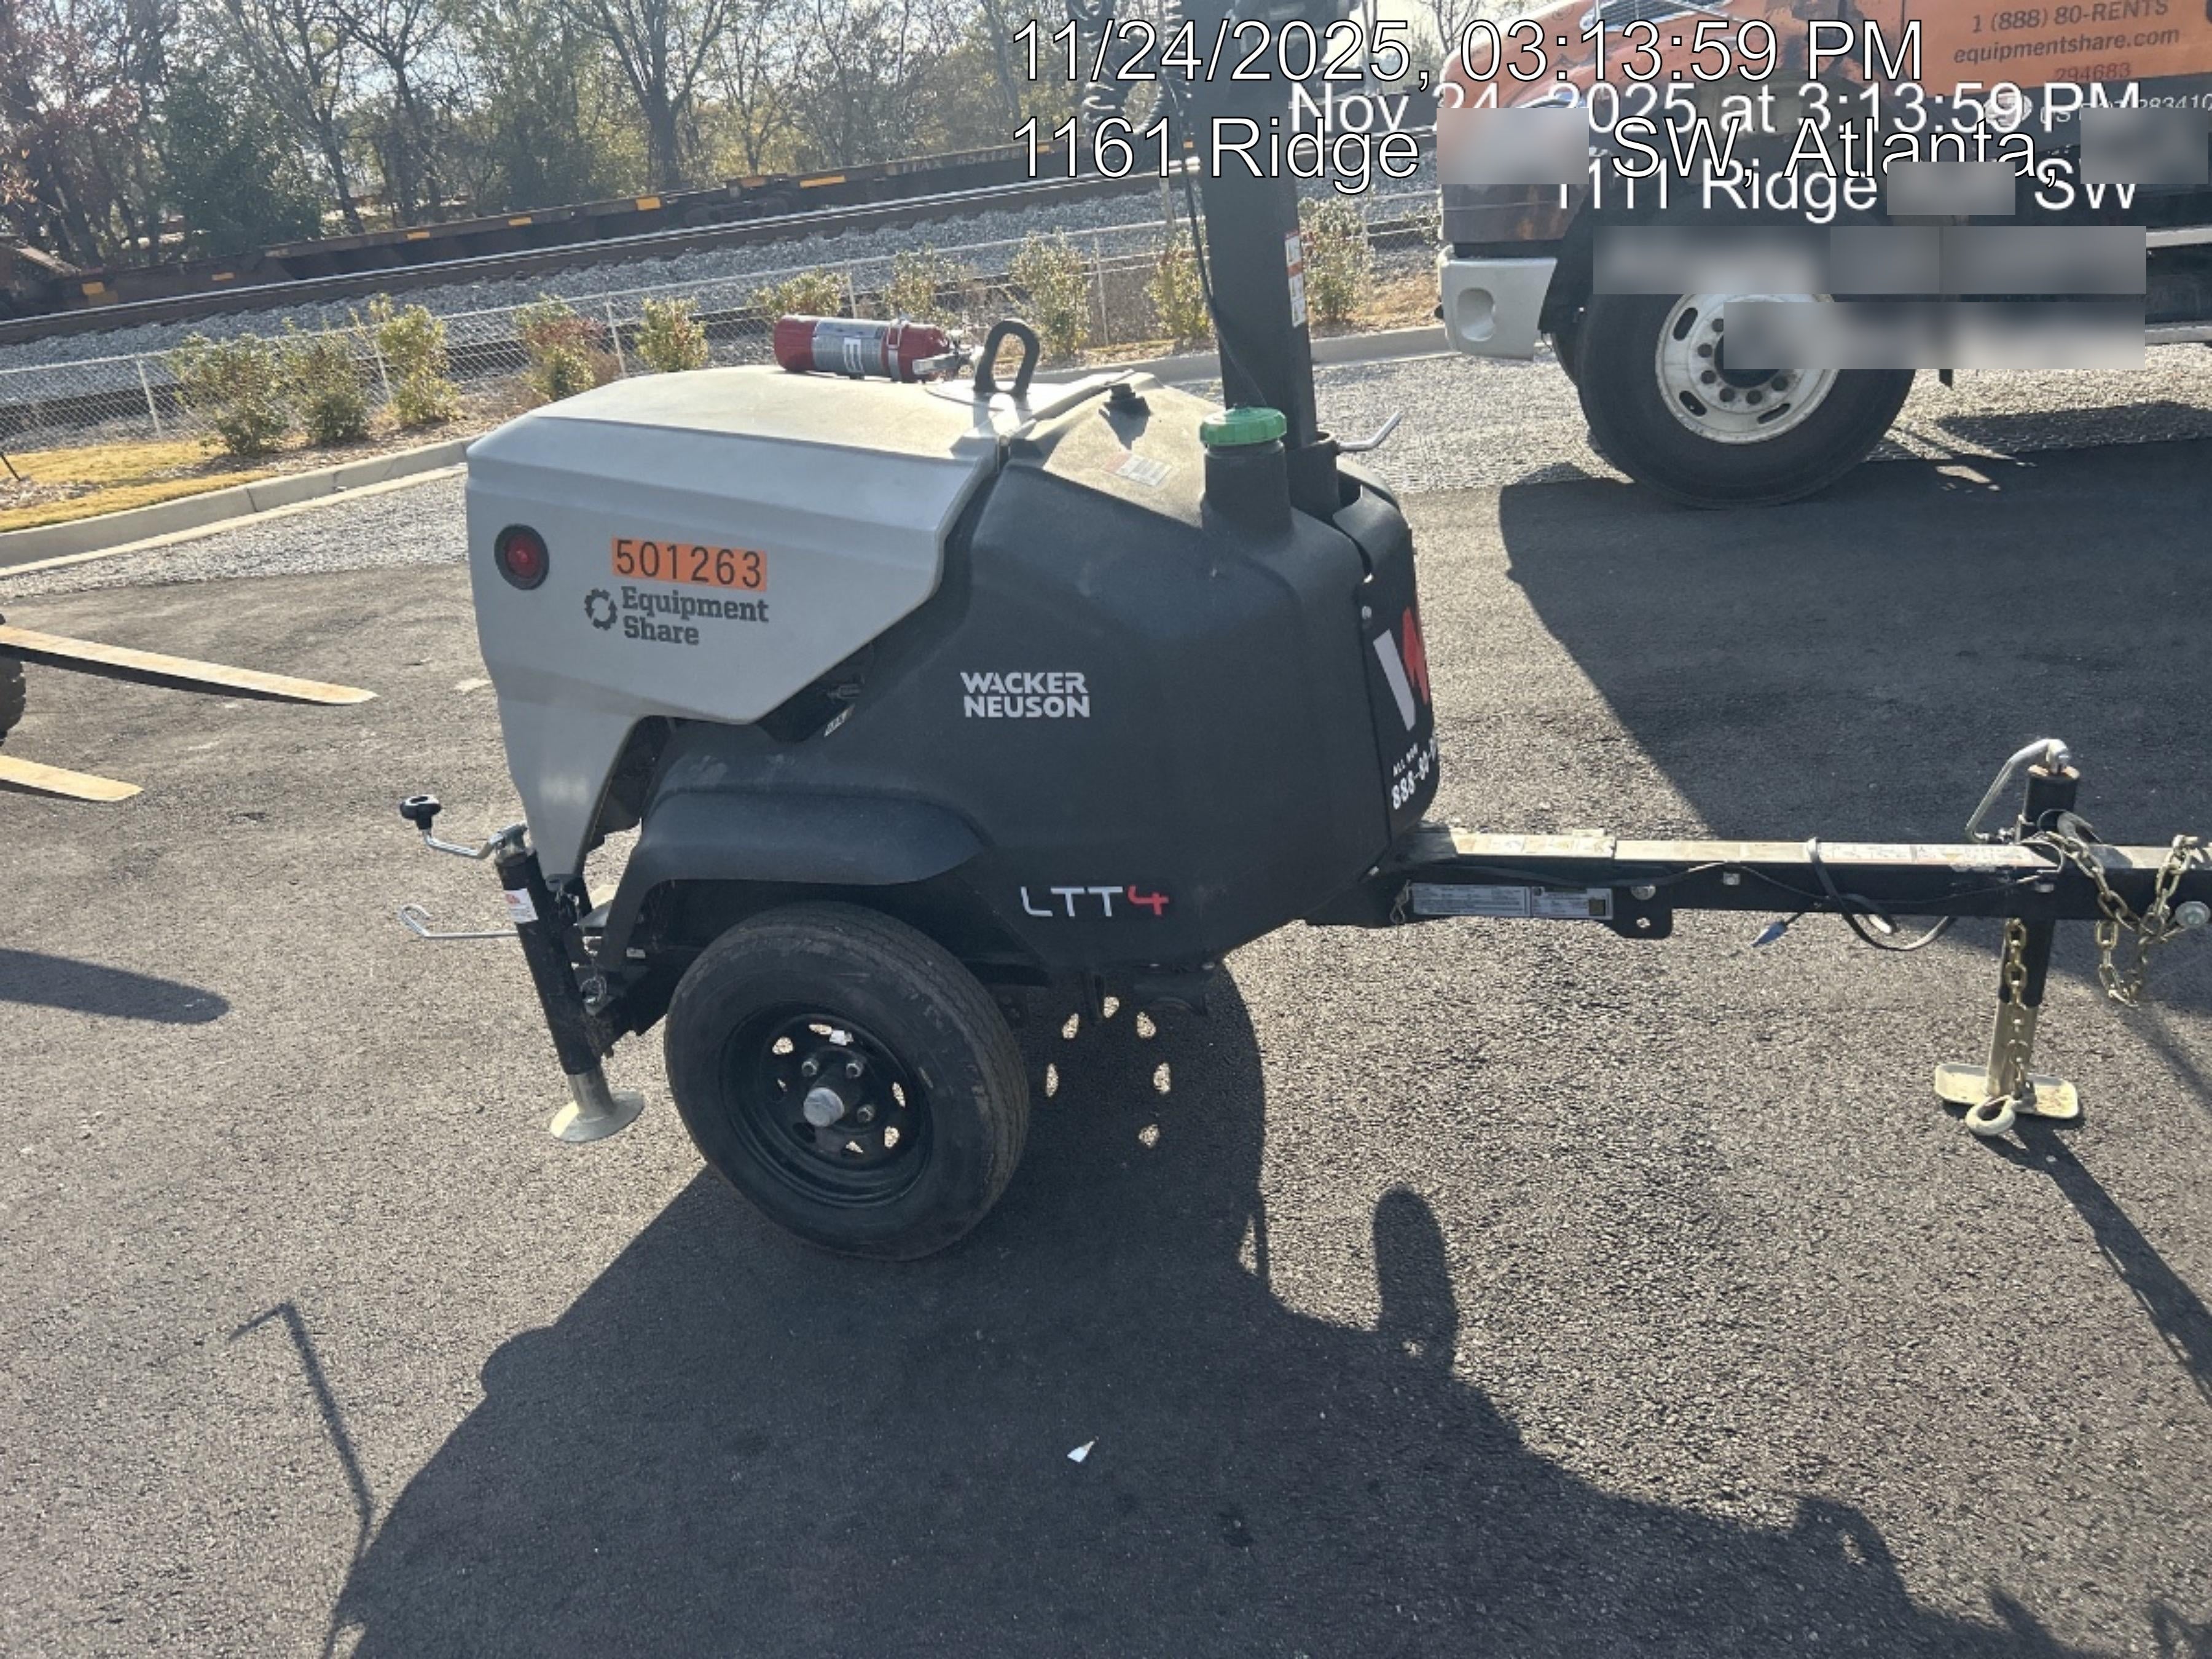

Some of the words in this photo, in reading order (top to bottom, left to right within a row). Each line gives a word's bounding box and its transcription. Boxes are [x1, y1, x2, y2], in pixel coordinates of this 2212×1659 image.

[1972, 15, 1983, 33] 1
[1990, 8, 2049, 32] (888)
[2053, 0, 2169, 25] 80-RENTS
[1953, 28, 2180, 65] equipmentshare.com
[616, 539, 761, 588] 501263
[621, 586, 769, 622] Equipment
[622, 615, 699, 646] Share
[960, 672, 1088, 694] WACKER
[963, 696, 1091, 718] NEUSON
[1020, 885, 1169, 917] LTT4
